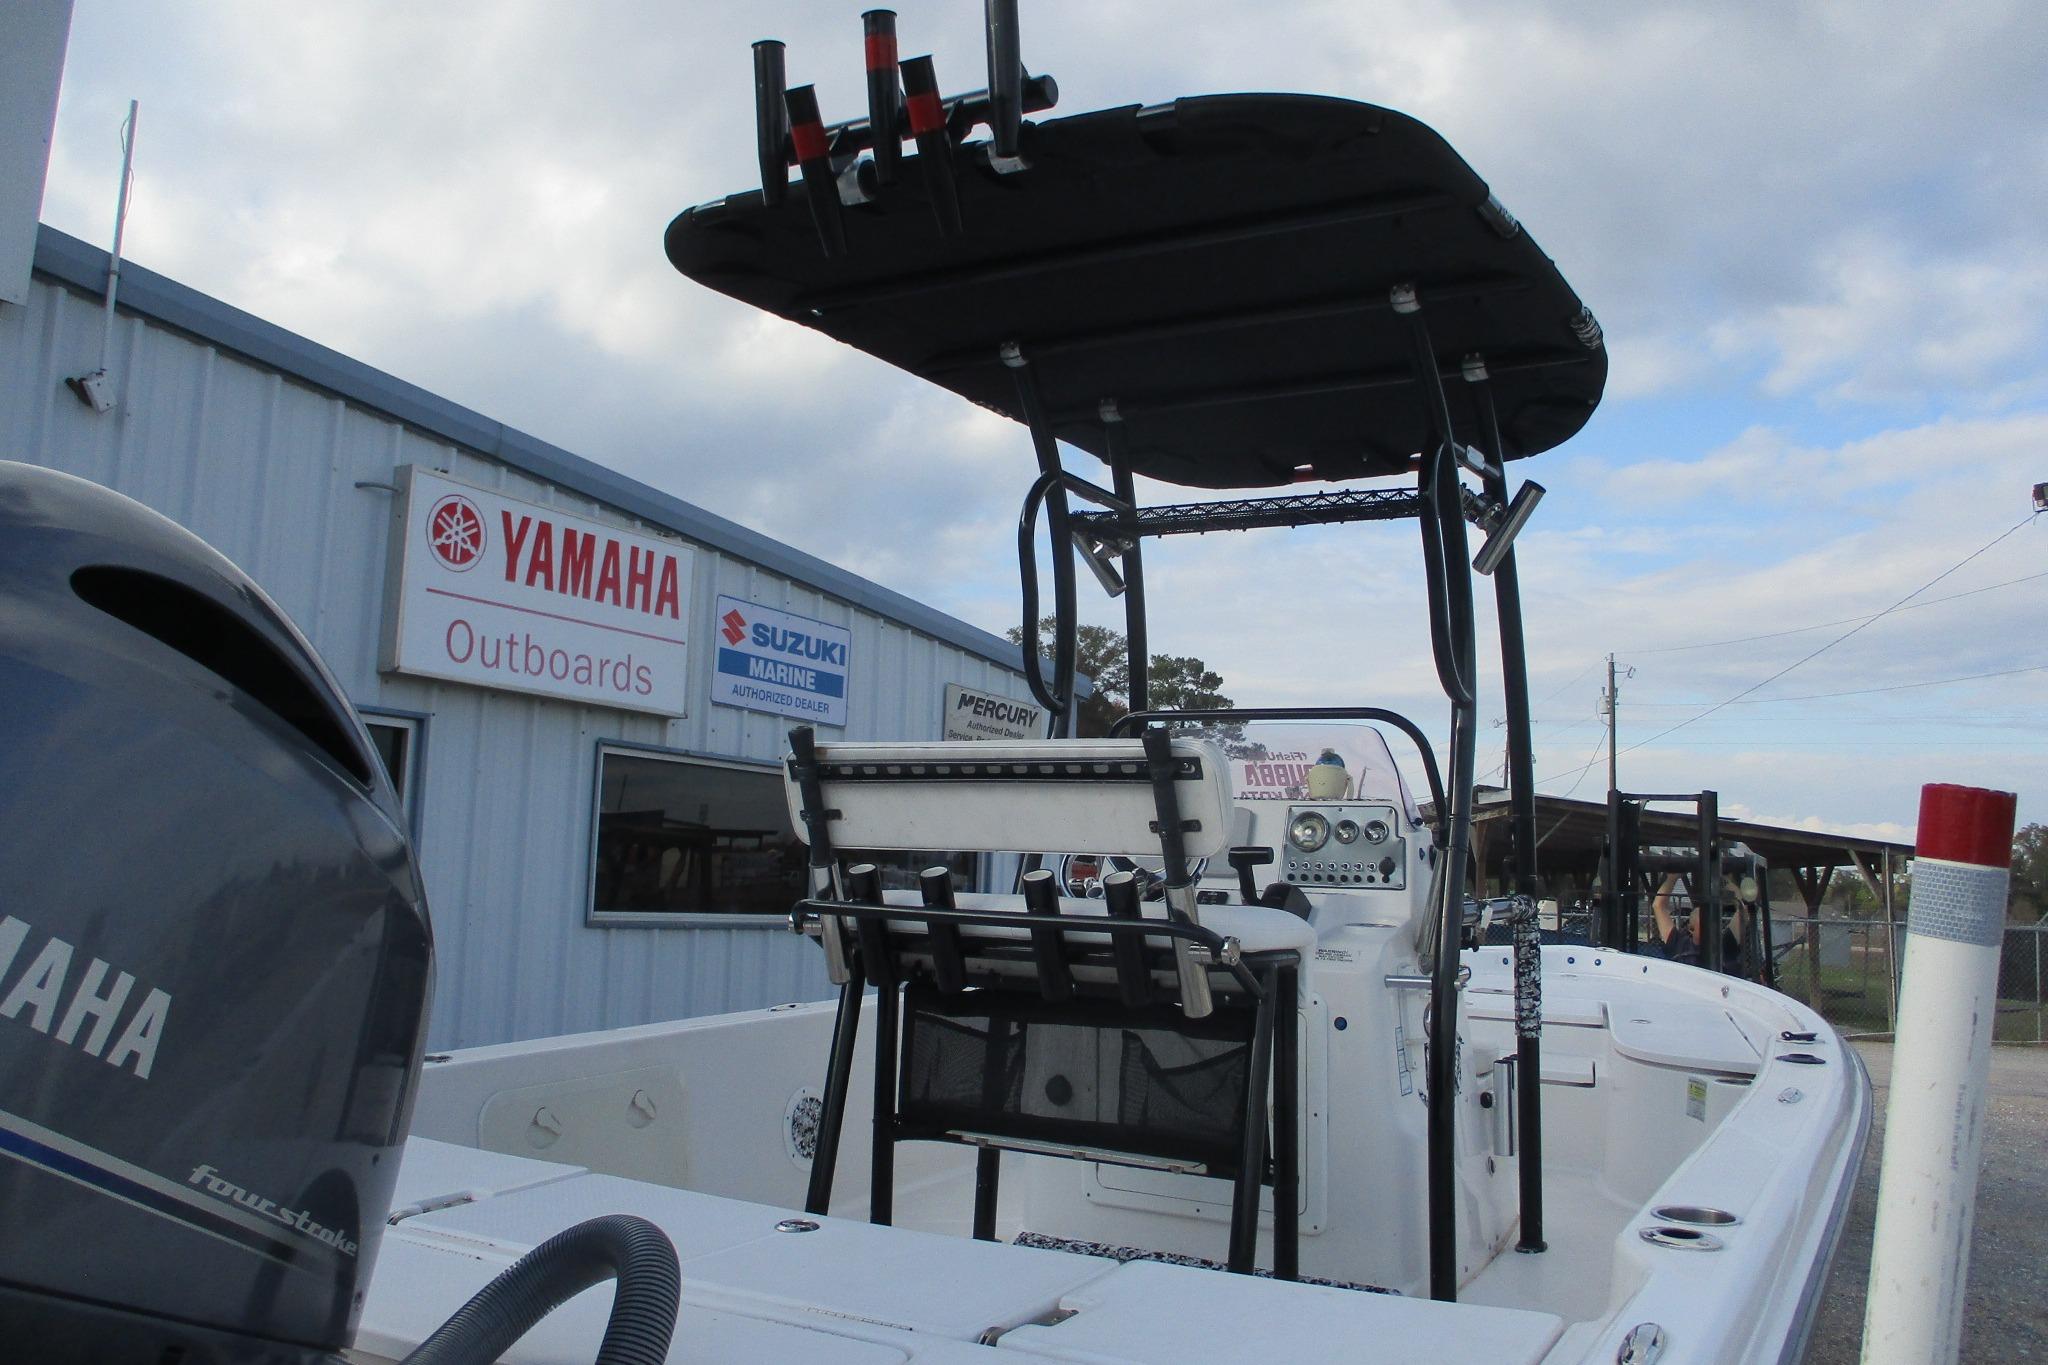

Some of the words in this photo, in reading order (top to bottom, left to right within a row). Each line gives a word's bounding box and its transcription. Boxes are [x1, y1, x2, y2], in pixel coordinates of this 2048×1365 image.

[501, 510, 680, 620] YAMAHA
[446, 619, 653, 696] Outboards
[752, 622, 846, 667] SUZUKI
[749, 657, 817, 690] MARINE
[732, 684, 793, 706] AUTHORIZED
[795, 697, 830, 714] DEALER
[957, 693, 1039, 728] MERCURY
[967, 720, 1003, 736] Authorized
[1004, 728, 1025, 740] Dealer
